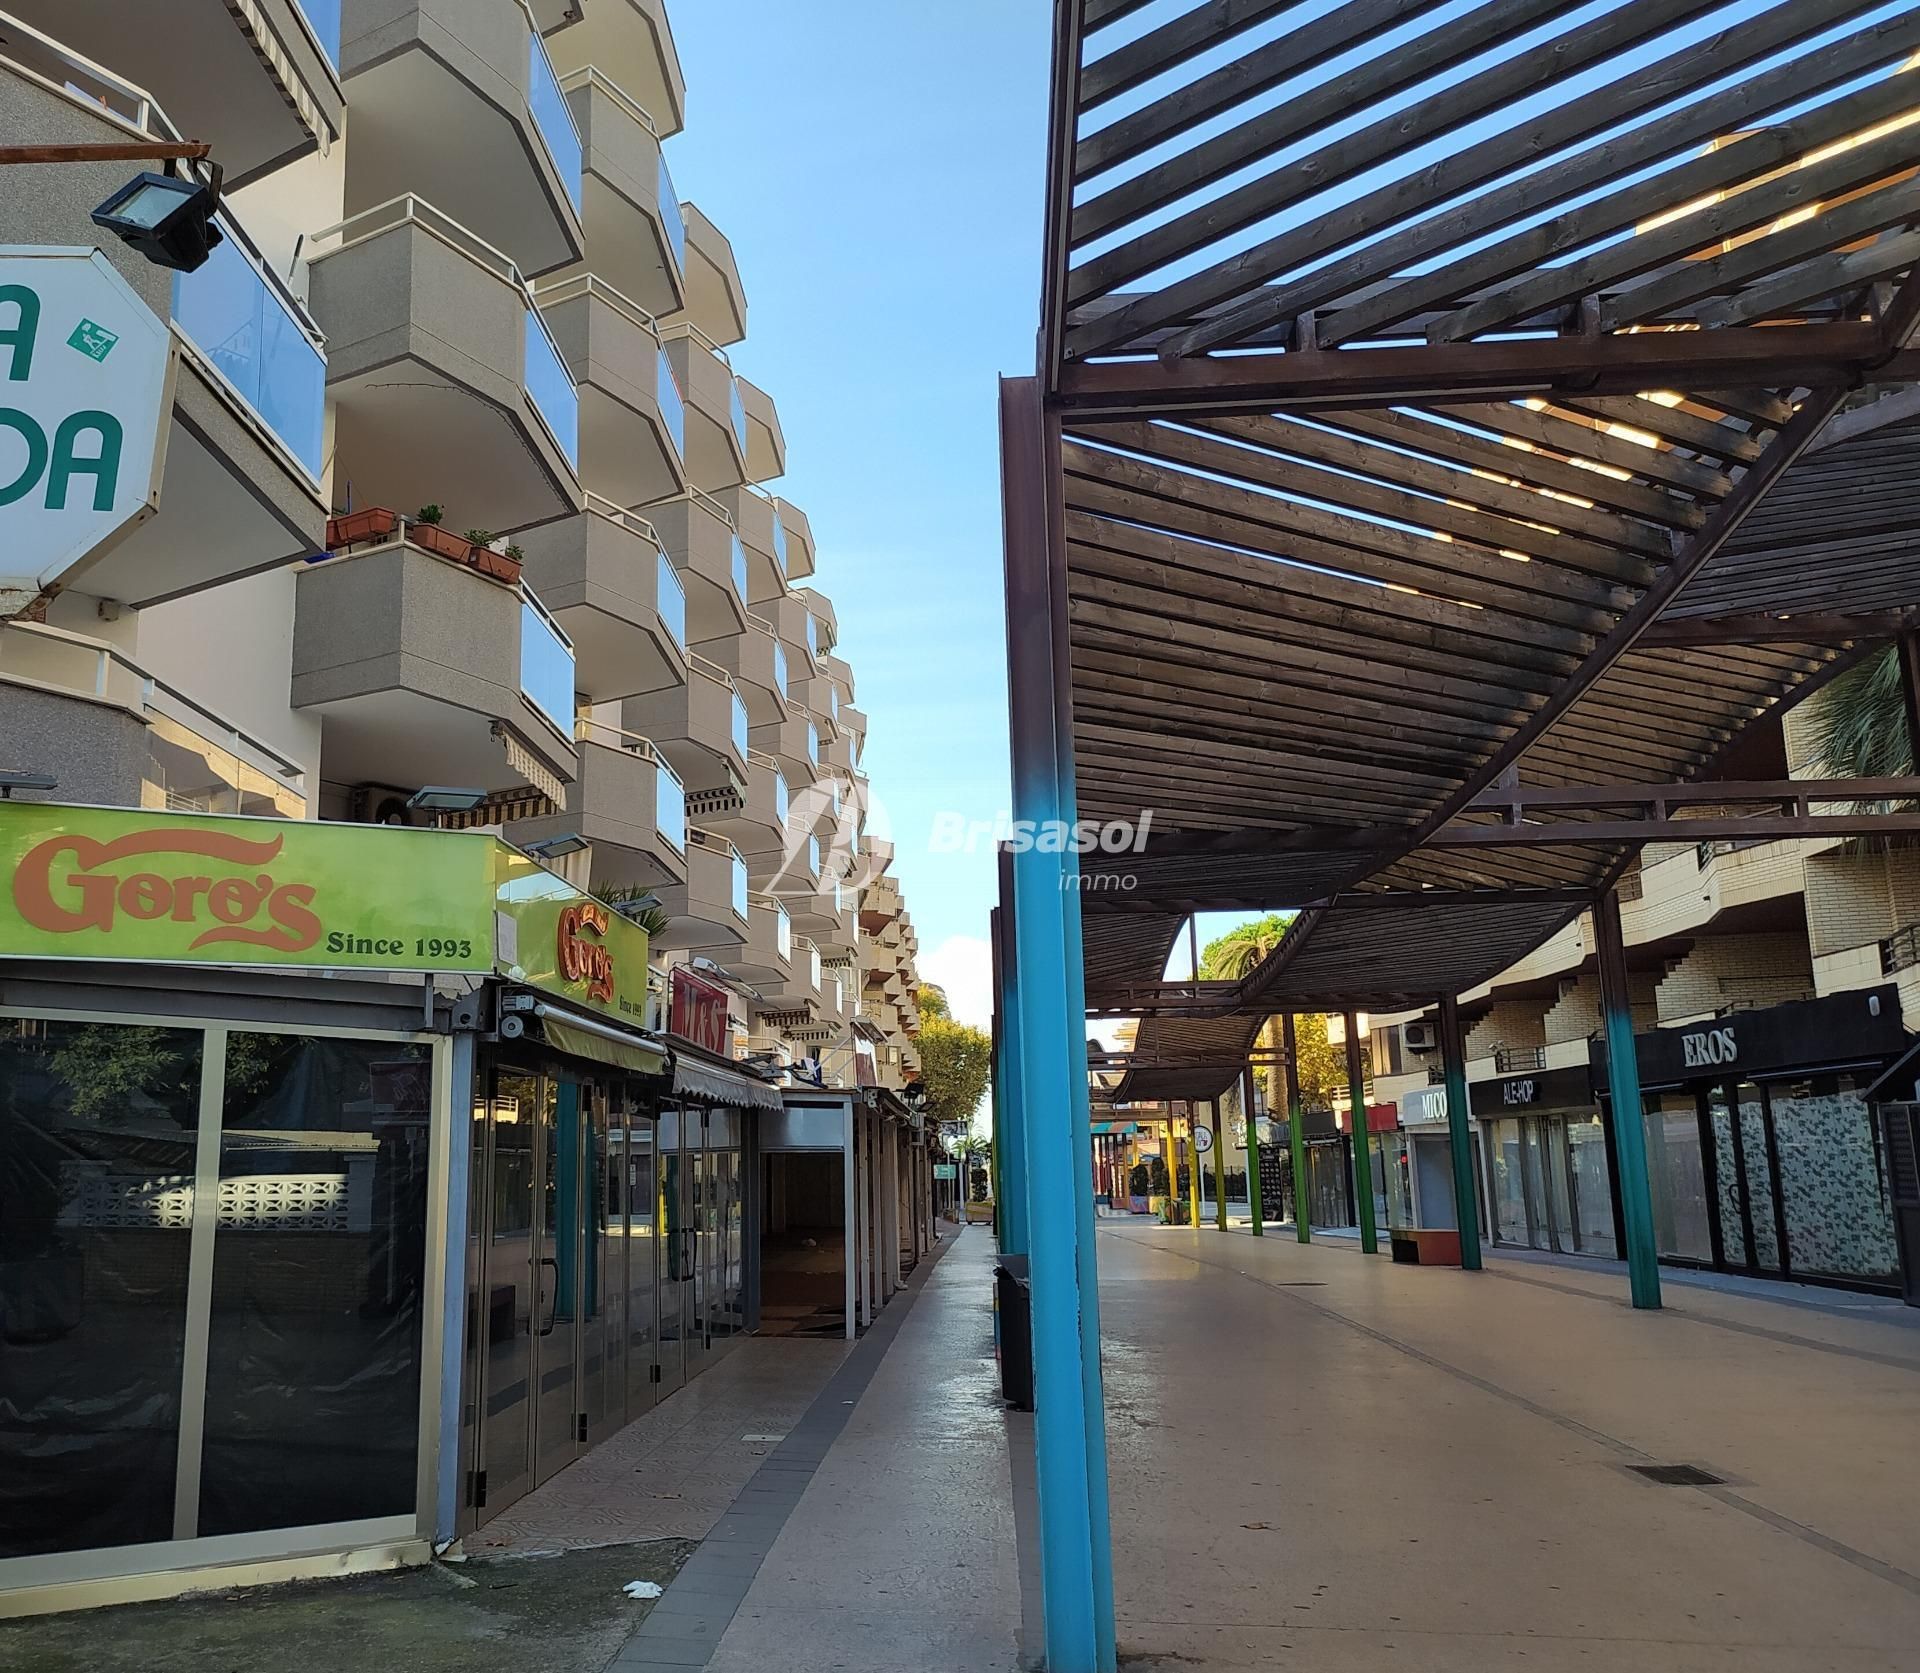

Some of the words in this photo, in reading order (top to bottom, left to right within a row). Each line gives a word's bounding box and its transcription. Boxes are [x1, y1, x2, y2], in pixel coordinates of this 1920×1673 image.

[13, 828, 322, 952] Goro's
[326, 931, 403, 956] Since
[415, 938, 472, 959] 1993
[1681, 1027, 1738, 1067] EROS
[1503, 1080, 1534, 1105] ALE-HOP
